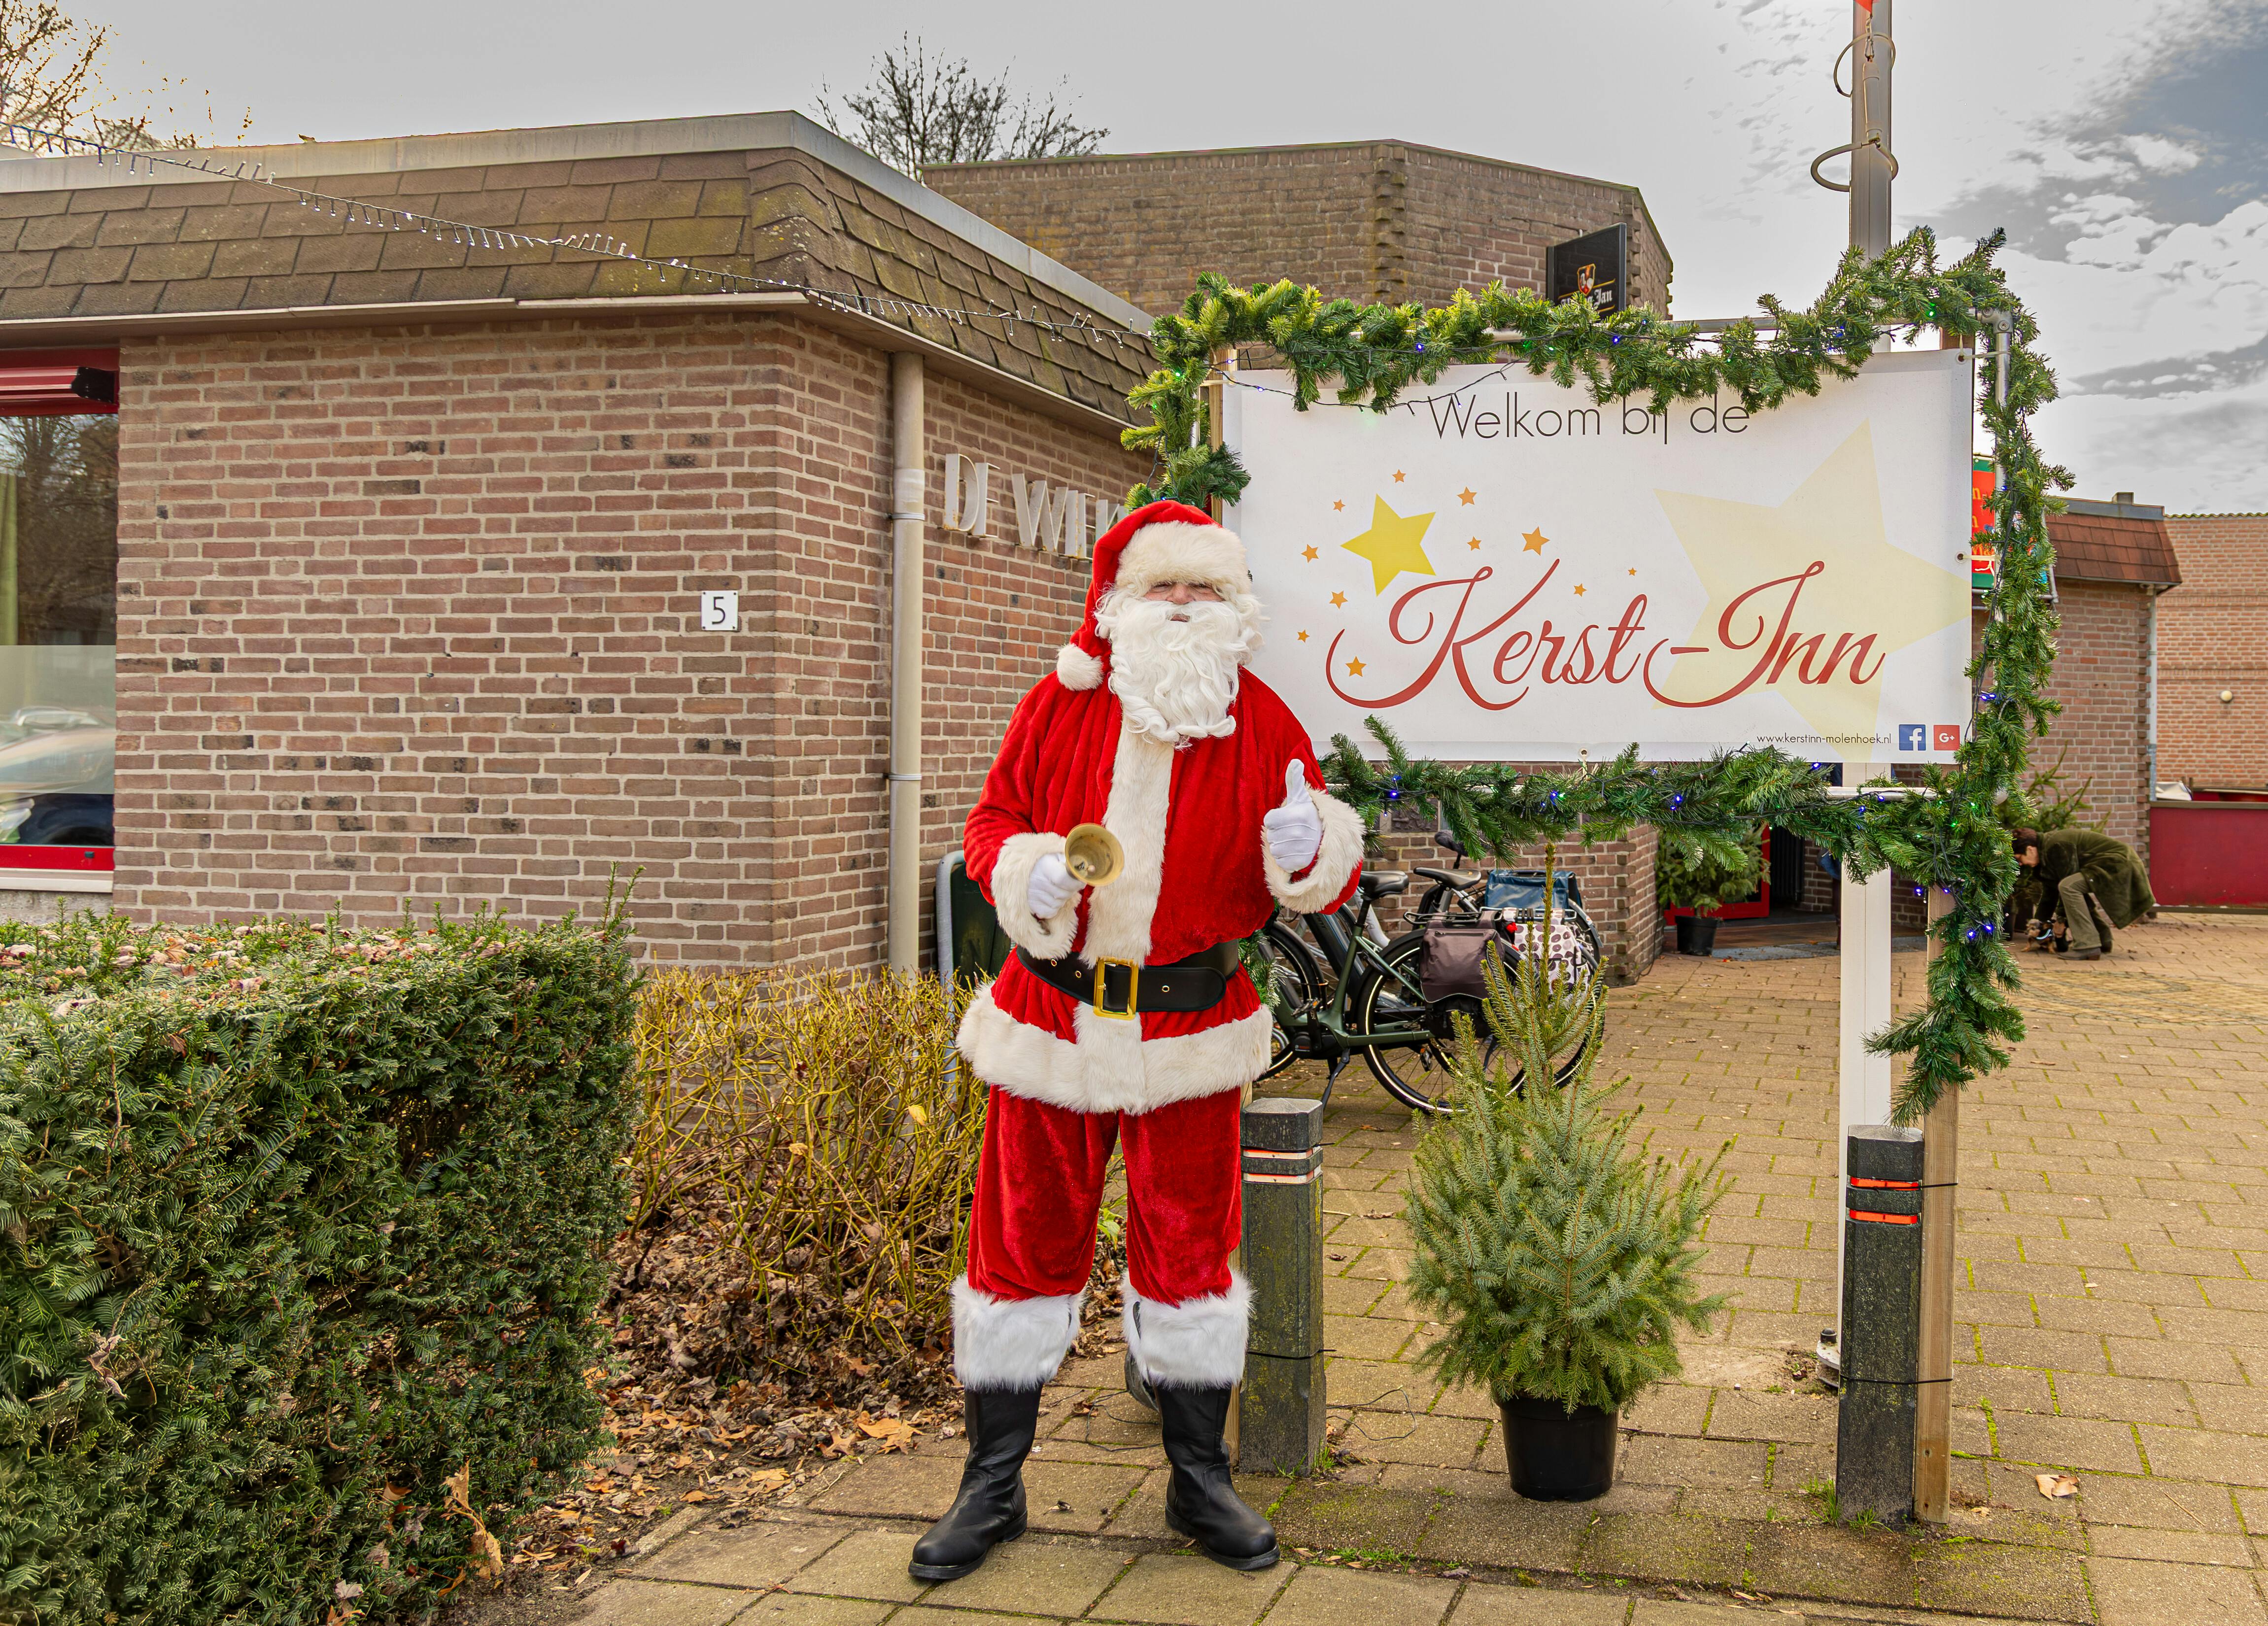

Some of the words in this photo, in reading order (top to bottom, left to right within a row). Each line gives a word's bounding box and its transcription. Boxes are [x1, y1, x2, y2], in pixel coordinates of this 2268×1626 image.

[1594, 288, 1613, 306] Jan
[1427, 392, 1601, 439] Welkom
[1623, 393, 1668, 445] bij
[1690, 393, 1750, 433] de
[943, 453, 1000, 538] DE
[712, 596, 726, 625] 5
[1756, 732, 1891, 745] www.kerstinn-molenhoek.nl
